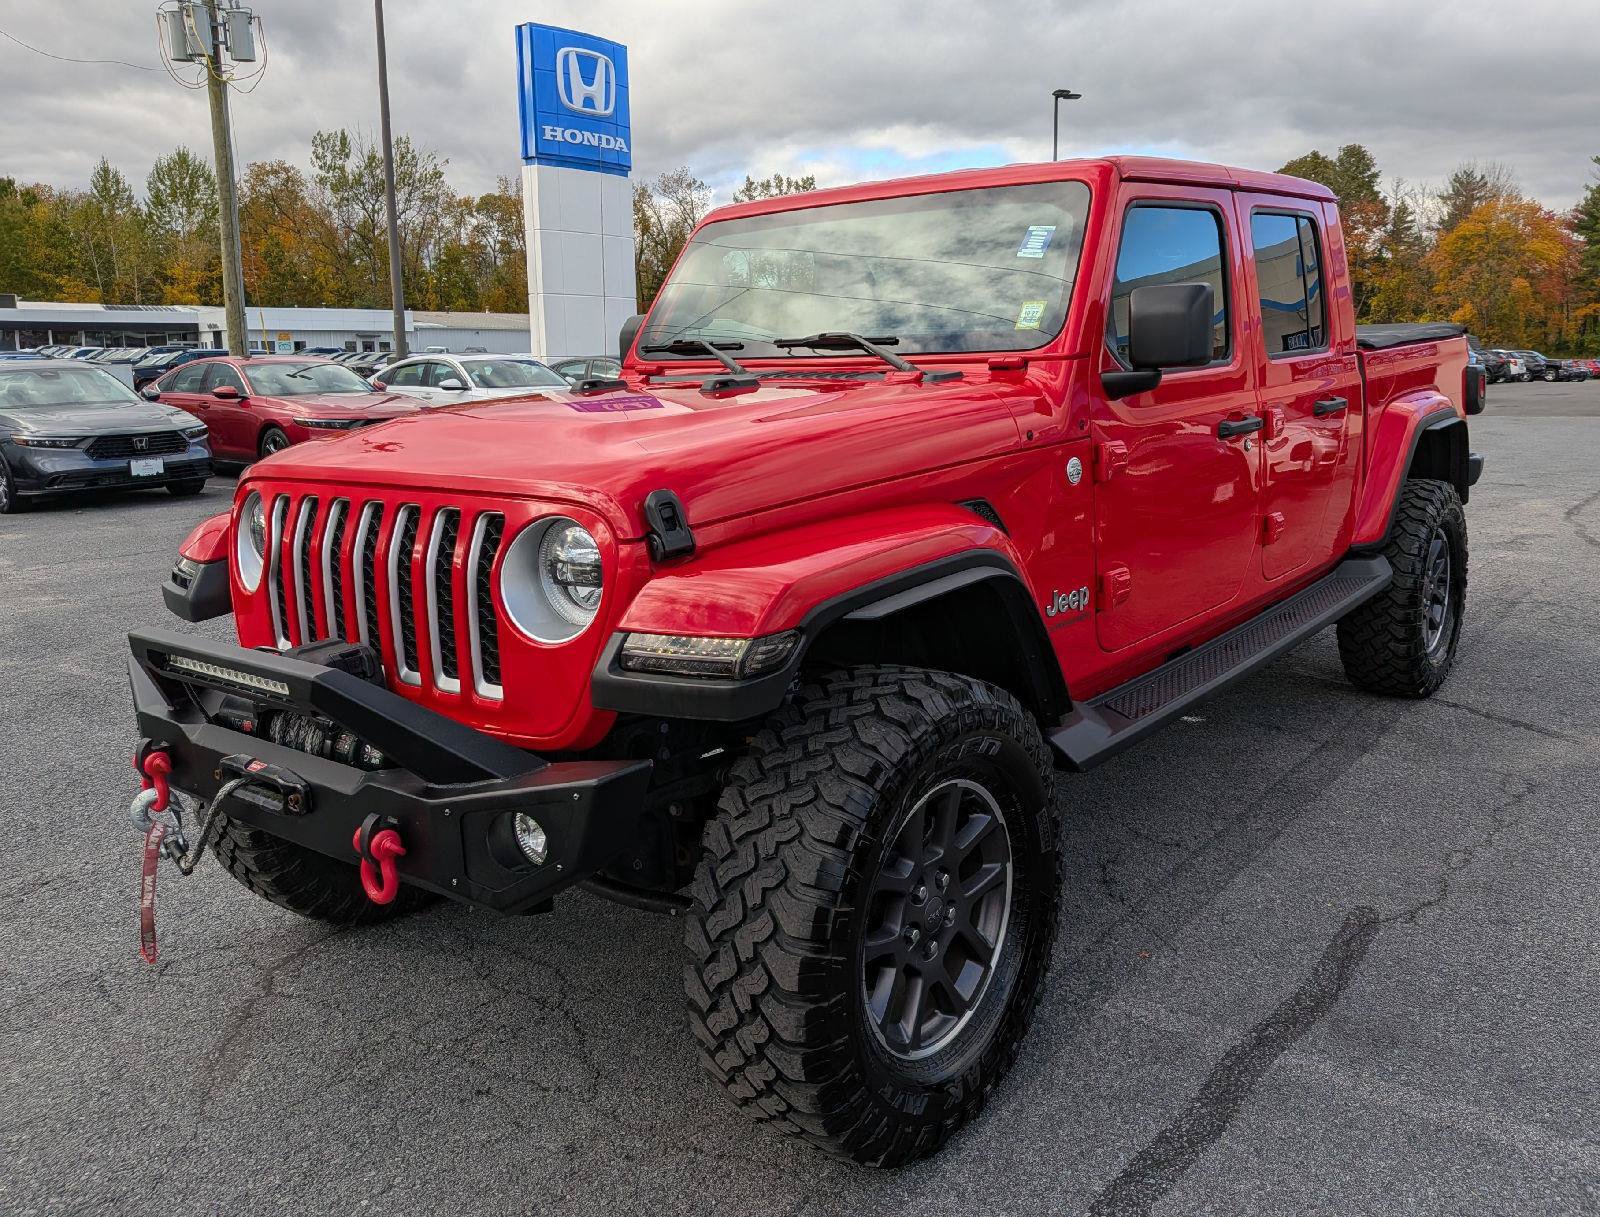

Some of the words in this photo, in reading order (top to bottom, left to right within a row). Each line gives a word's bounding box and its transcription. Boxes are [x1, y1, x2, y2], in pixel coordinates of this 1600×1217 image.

[542, 125, 629, 152] HONDA
[1046, 586, 1089, 616] Jeep
[141, 874, 154, 908] WARN
